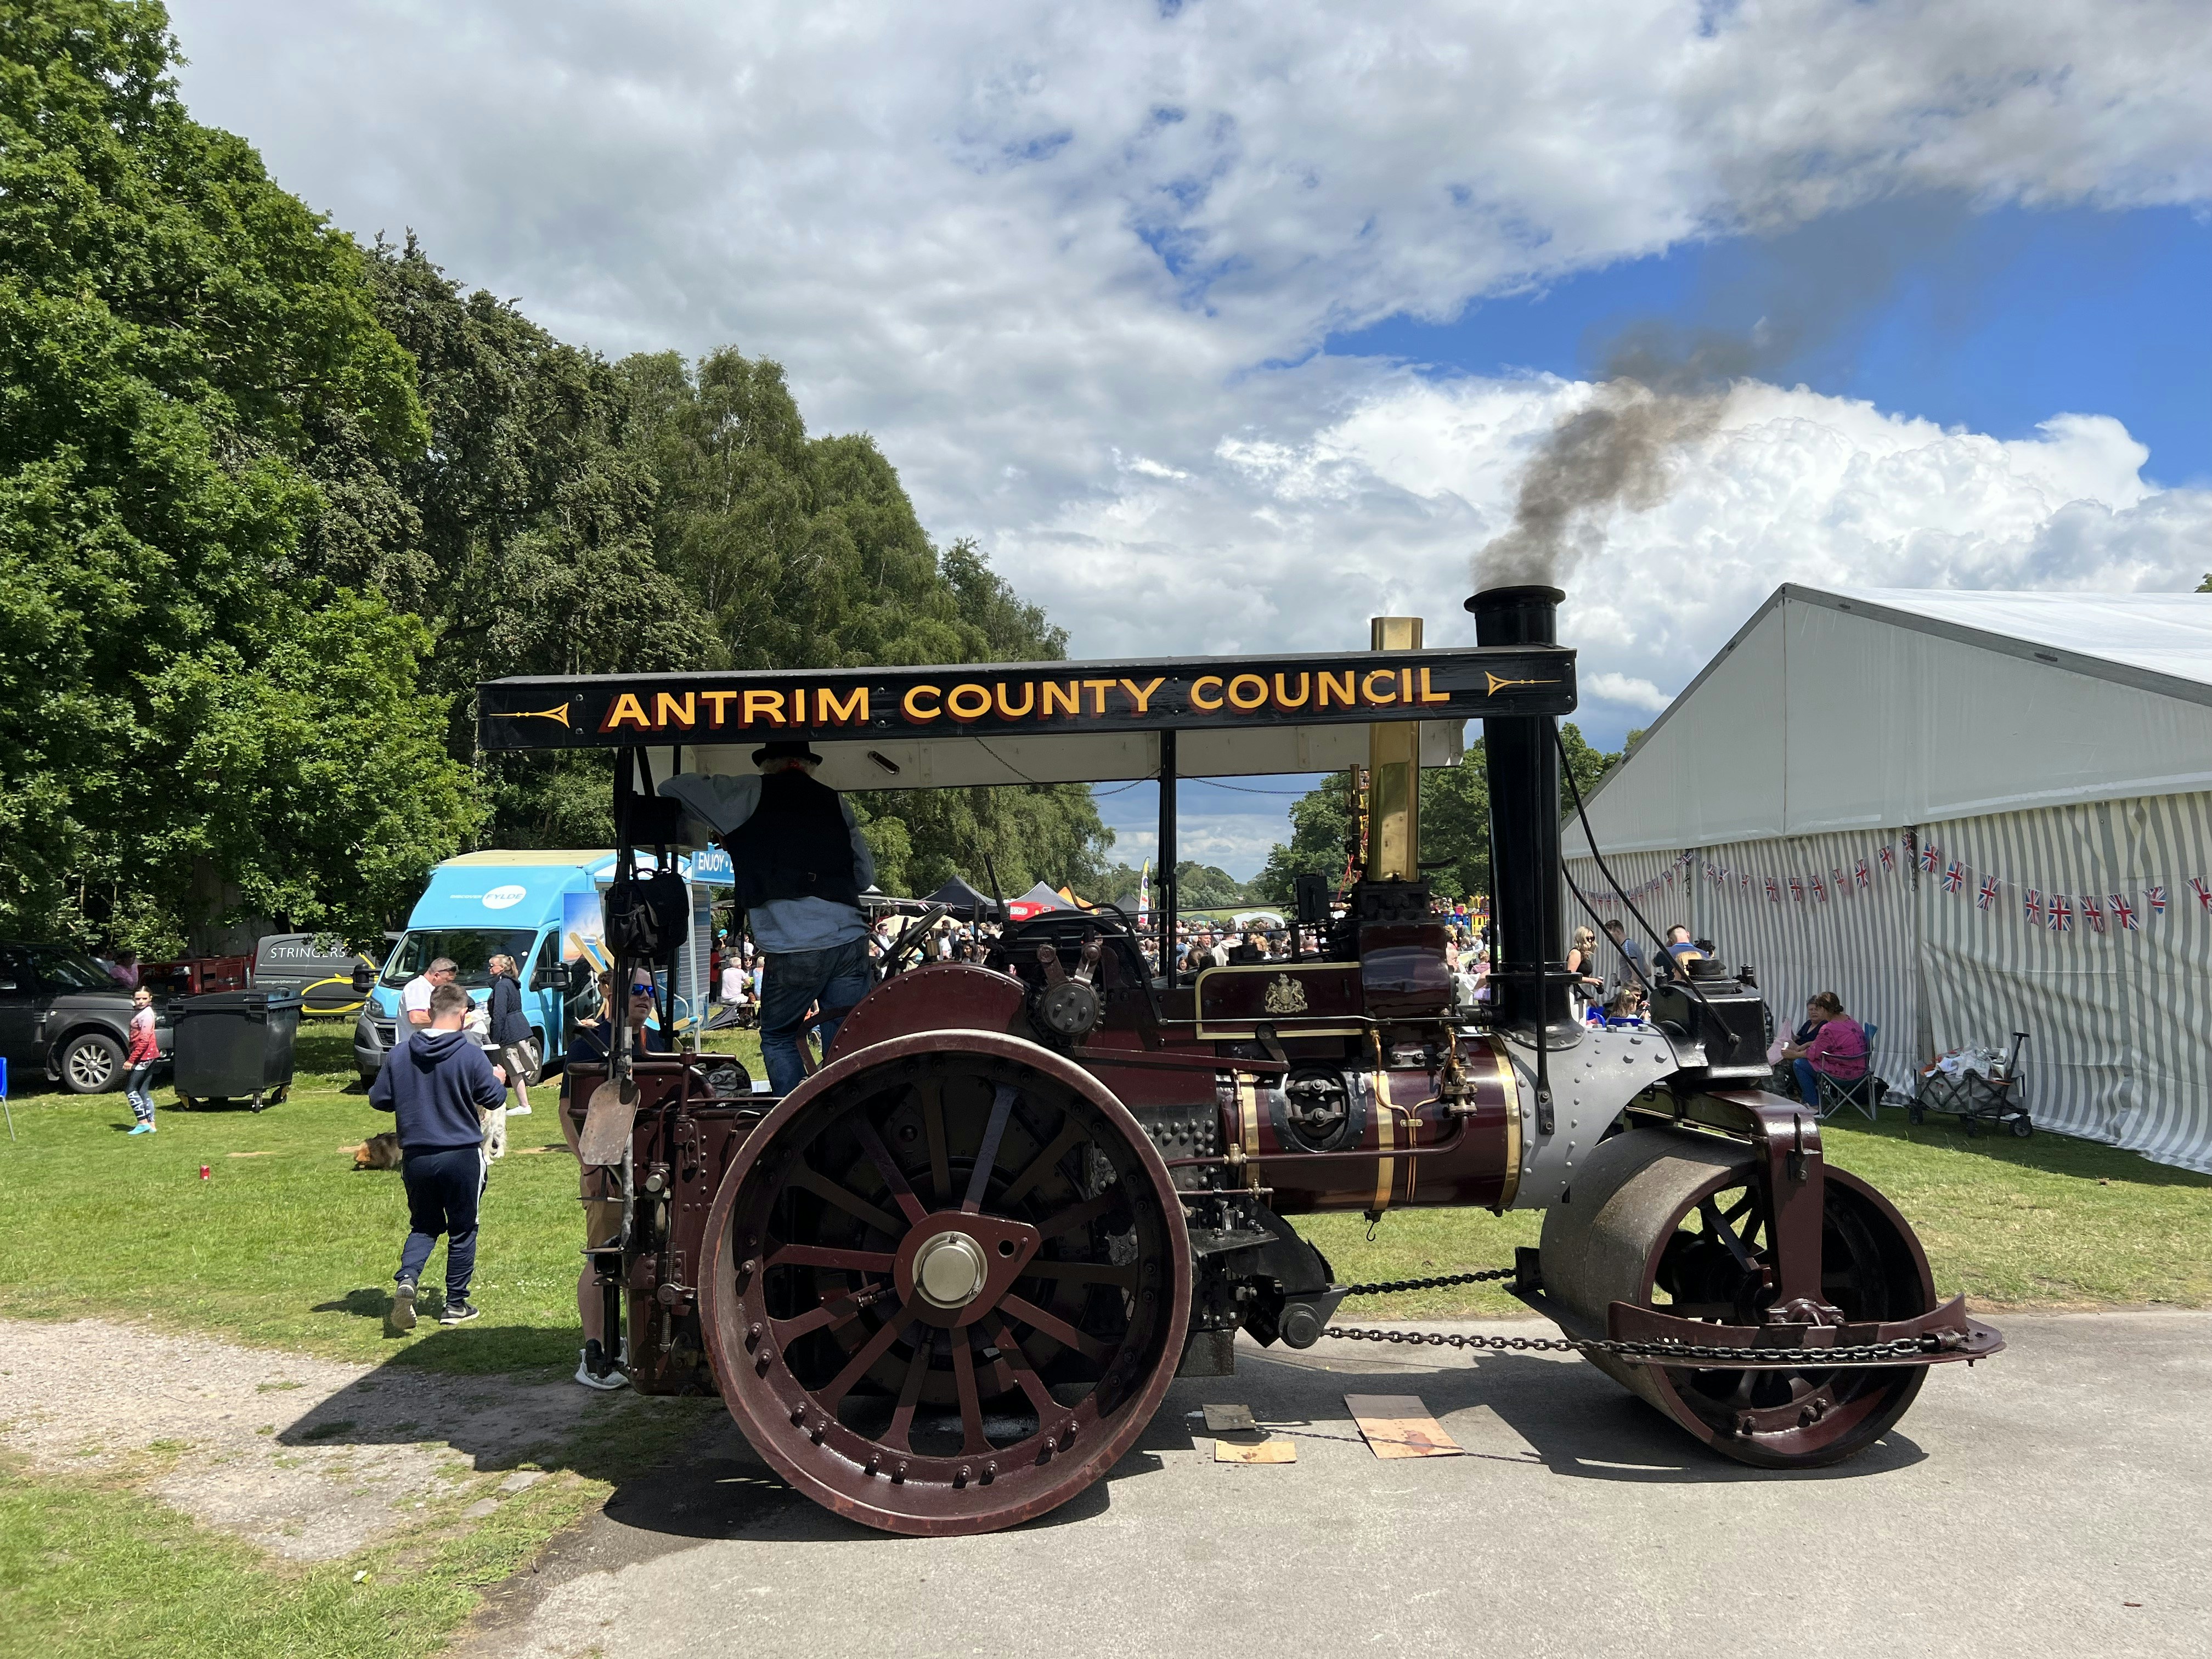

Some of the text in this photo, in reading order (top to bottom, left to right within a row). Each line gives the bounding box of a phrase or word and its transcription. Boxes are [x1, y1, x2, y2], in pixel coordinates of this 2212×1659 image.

[606, 668, 1450, 728] ANTRIM COUNTY COUNCIL
[698, 852, 725, 872] ENJOY
